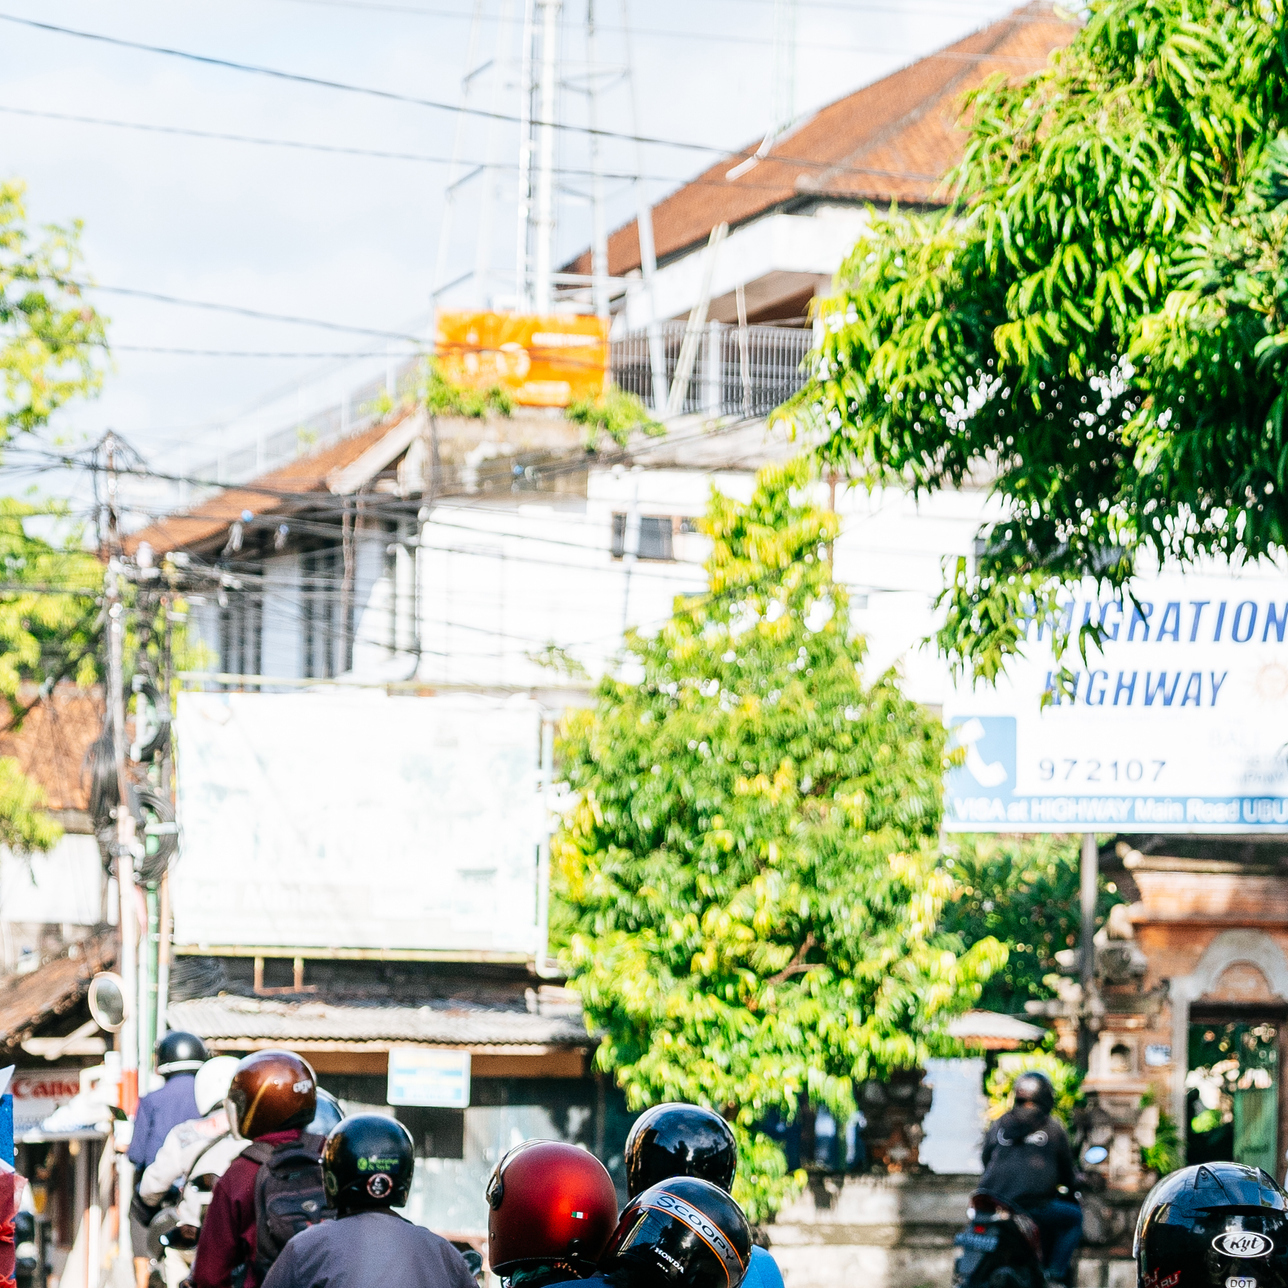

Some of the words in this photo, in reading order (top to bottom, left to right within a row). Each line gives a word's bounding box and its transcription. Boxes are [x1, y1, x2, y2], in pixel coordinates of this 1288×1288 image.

[1039, 757, 1167, 783] 972107
[1031, 797, 1133, 822] HIGHWAY
[1135, 798, 1184, 822] Main
[1187, 798, 1241, 822] Road
[656, 1195, 734, 1261] SCOOPY
[654, 1247, 685, 1274] HONDA
[1230, 1279, 1254, 1288] DOT
